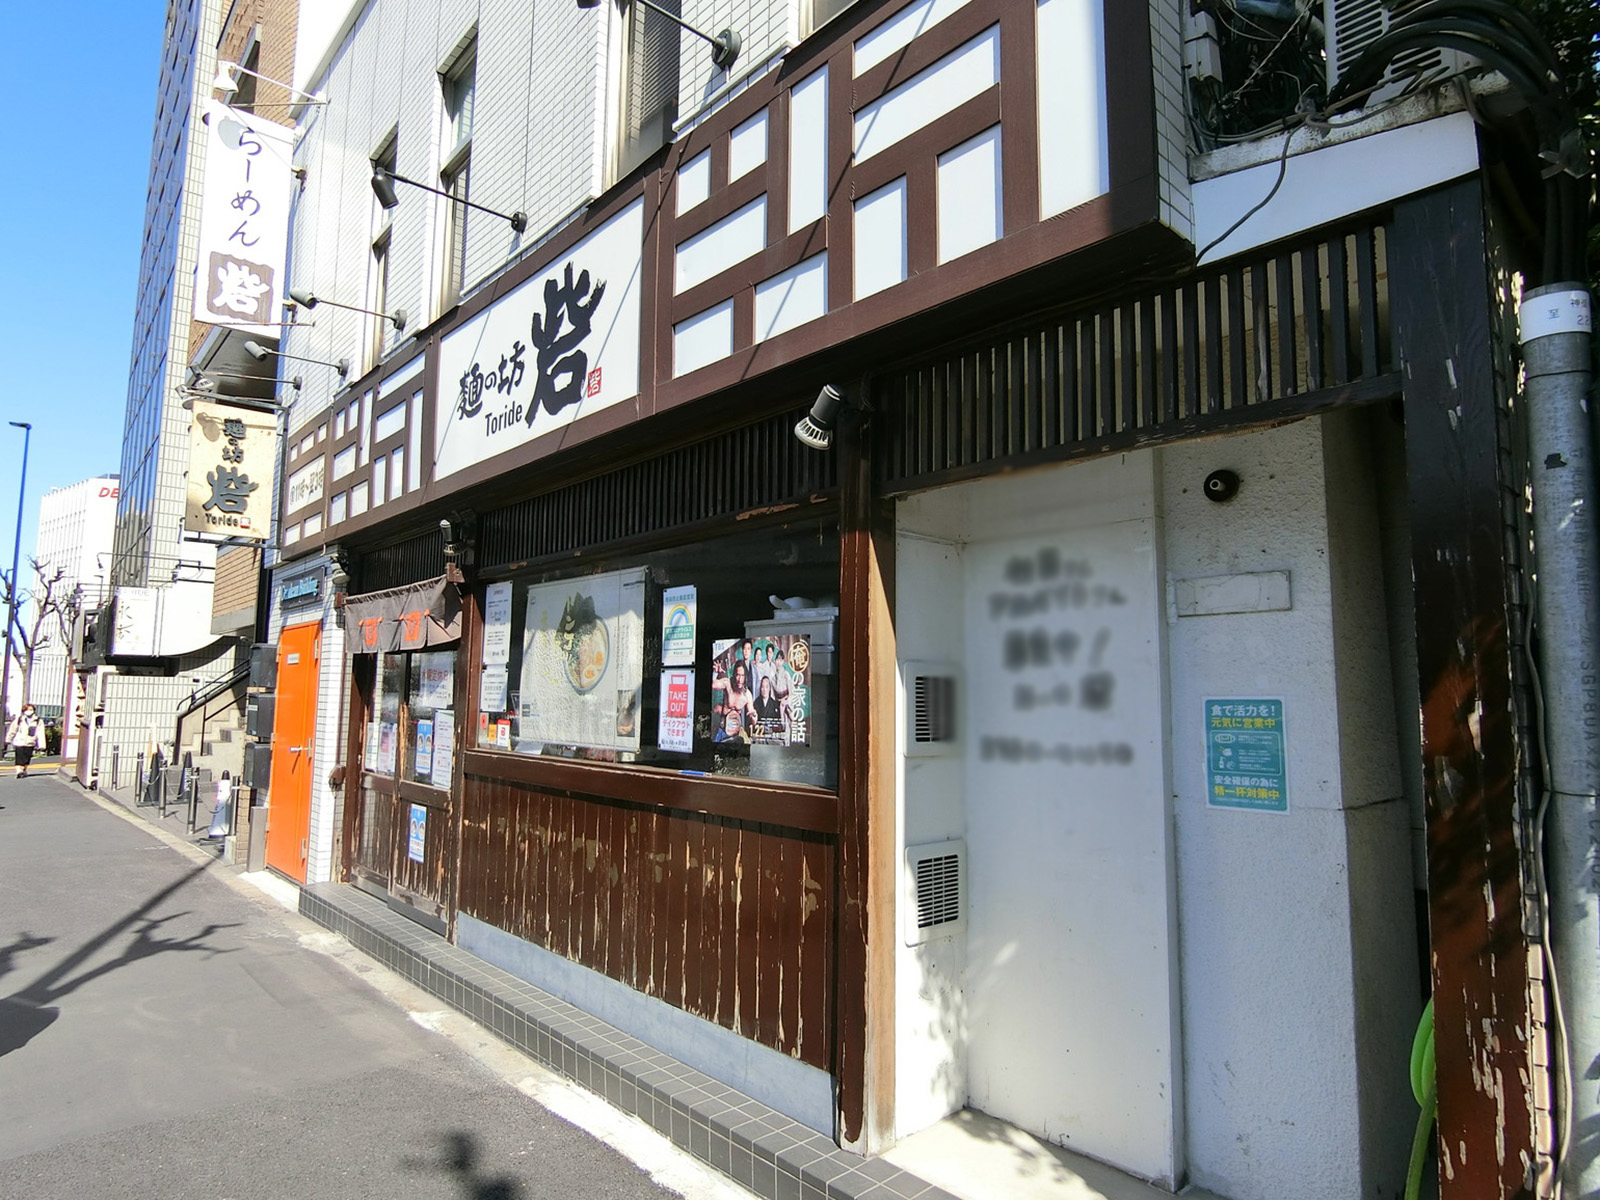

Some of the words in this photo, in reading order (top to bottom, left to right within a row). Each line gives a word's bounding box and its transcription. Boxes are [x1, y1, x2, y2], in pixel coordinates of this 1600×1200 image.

[228, 127, 263, 247] らーめん
[484, 401, 523, 437] Toride
[205, 513, 239, 527] Toride
[669, 691, 688, 700] TAKE
[787, 641, 809, 743] 俺の家の話
[670, 702, 685, 712] OUT
[662, 719, 690, 729] テイクアウト
[667, 728, 686, 737] できます
